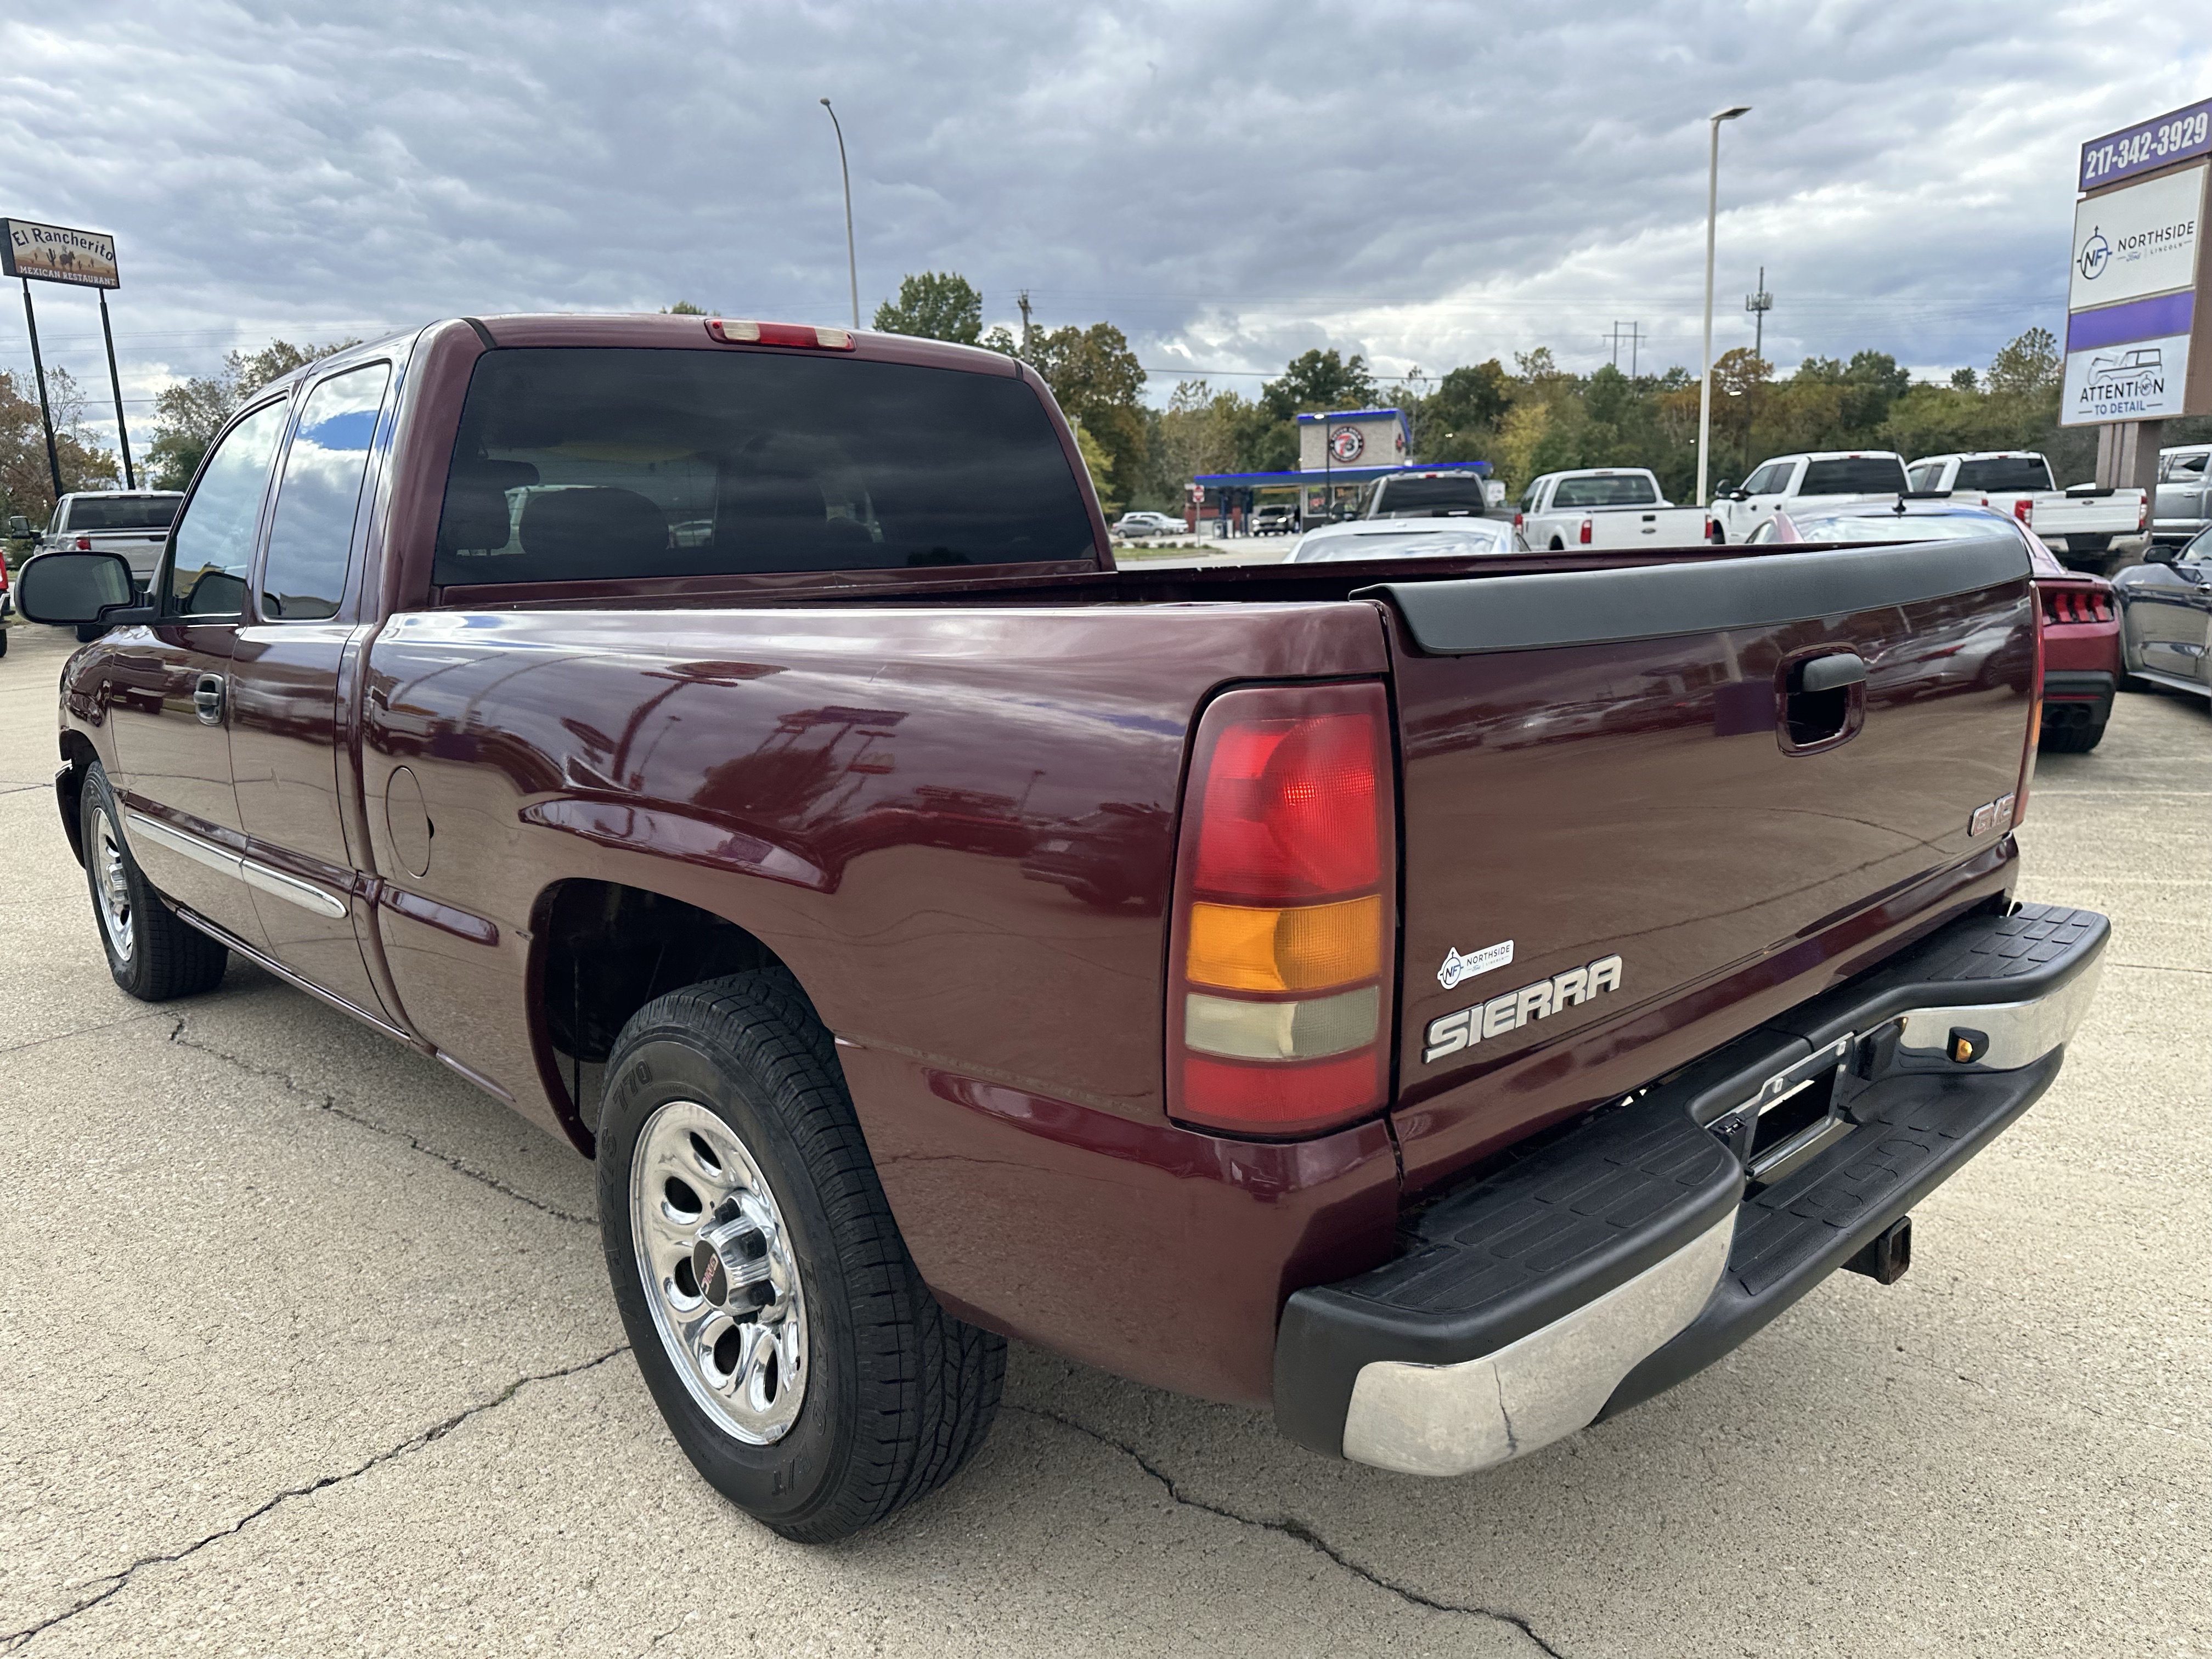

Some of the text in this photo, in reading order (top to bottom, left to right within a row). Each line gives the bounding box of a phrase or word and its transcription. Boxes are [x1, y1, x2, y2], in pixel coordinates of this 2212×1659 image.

[2086, 112, 2208, 179] 217-342-3929
[12, 228, 114, 261] El Rancherito
[2118, 221, 2194, 252] NORTHSIDE
[20, 266, 115, 286] MEXICAN RESTAURANT
[2080, 377, 2164, 403] ATTENTION
[2095, 400, 2146, 415] TO DETAIL
[1971, 792, 2015, 837] GMC
[1466, 944, 1510, 967] NORTHSIDE
[1423, 953, 1622, 1064] SIERRA
[613, 1060, 653, 1113] 770
[701, 1253, 719, 1295] GMC
